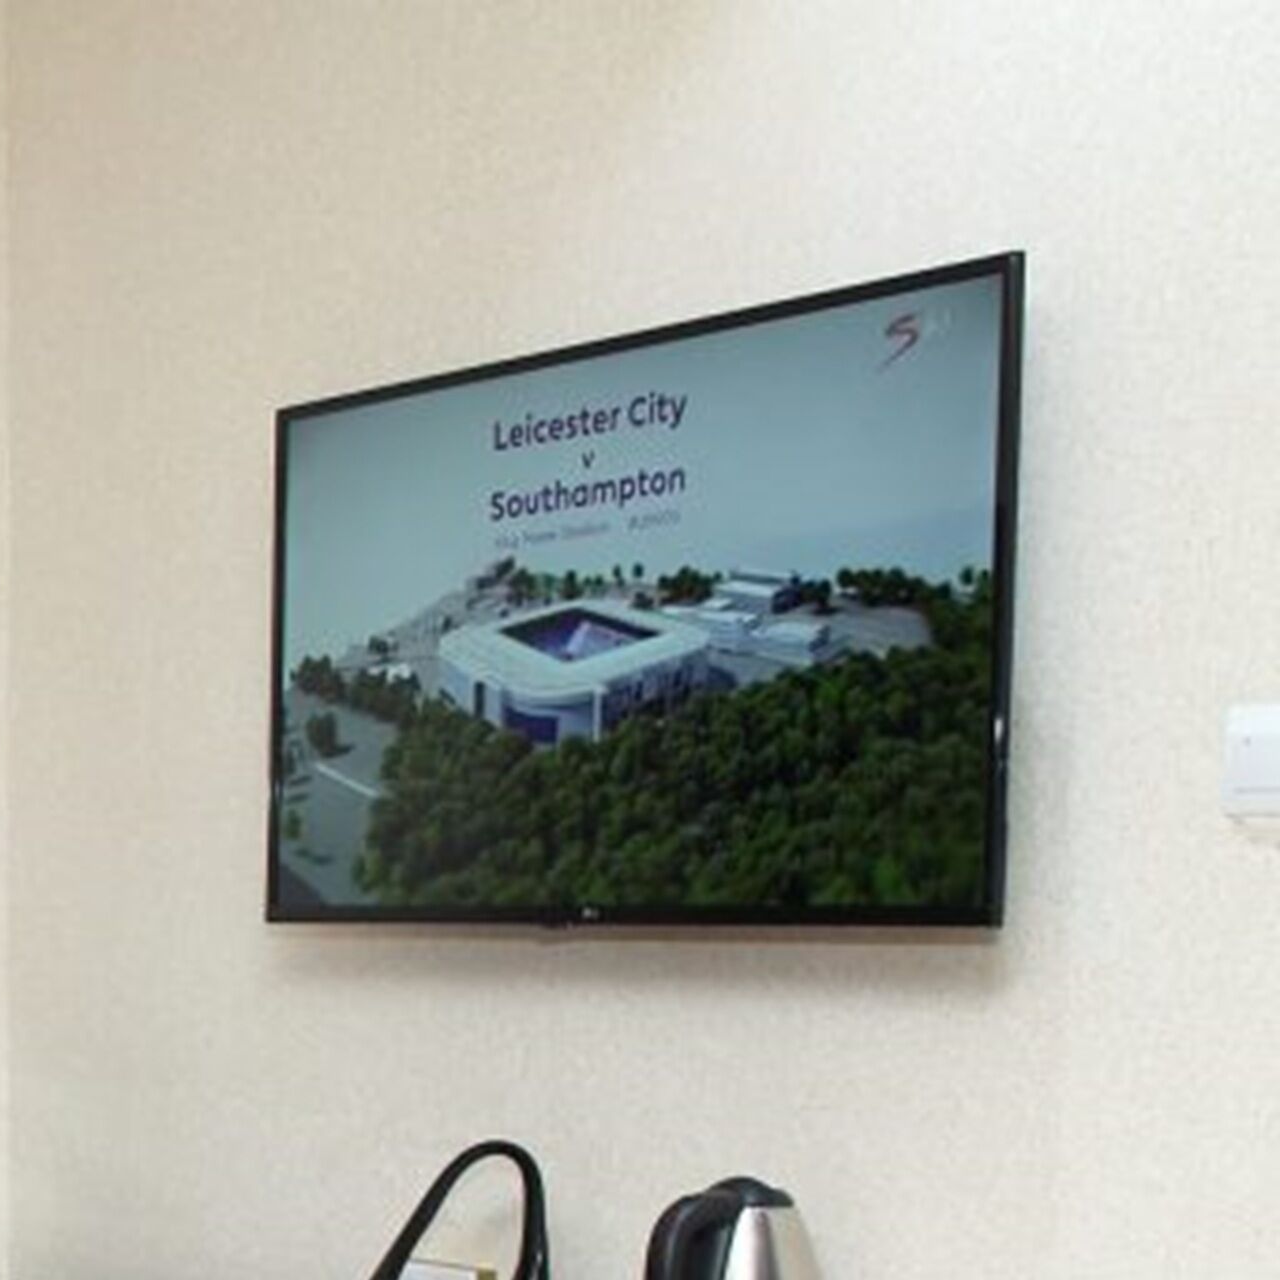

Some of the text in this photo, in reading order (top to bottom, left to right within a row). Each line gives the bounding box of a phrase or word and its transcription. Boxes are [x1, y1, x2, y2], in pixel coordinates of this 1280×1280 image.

[493, 391, 689, 451] Leicester City
[581, 450, 596, 469] v
[490, 467, 686, 522] Southampton
